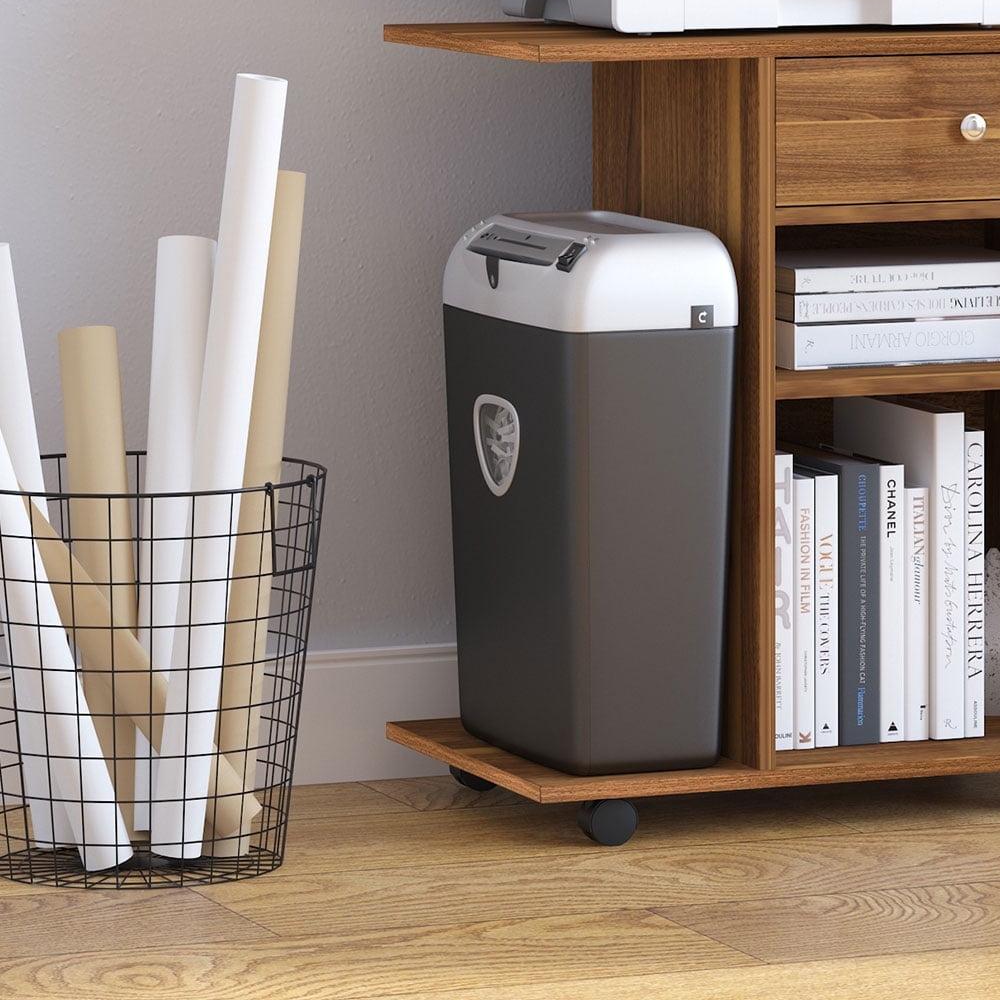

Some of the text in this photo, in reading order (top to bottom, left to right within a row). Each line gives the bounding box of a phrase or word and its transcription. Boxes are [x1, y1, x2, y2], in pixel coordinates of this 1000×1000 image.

[813, 302, 853, 315] PEOPLE
[950, 296, 984, 308] LIVING
[849, 329, 976, 350] GIORGIO ARMANI
[857, 474, 867, 532] CHOUPETTE
[887, 479, 896, 538] CHANEL
[941, 483, 961, 534] Dior
[800, 507, 811, 614] FASHION IN FILM
[859, 536, 867, 547] THE
[910, 496, 925, 605] ITALIAN glamour
[818, 533, 833, 590] VOGUE
[859, 549, 867, 573] PRIVATE
[967, 442, 983, 680] CAROLINA HERRERA
[859, 574, 867, 587] LIFE
[859, 588, 867, 598] OF
[859, 605, 867, 643] HIGH-FLYING
[819, 622, 832, 676] COVERS
[859, 644, 867, 671] FASHION
[859, 672, 867, 683] CAT
[857, 687, 866, 726] Flammarion
